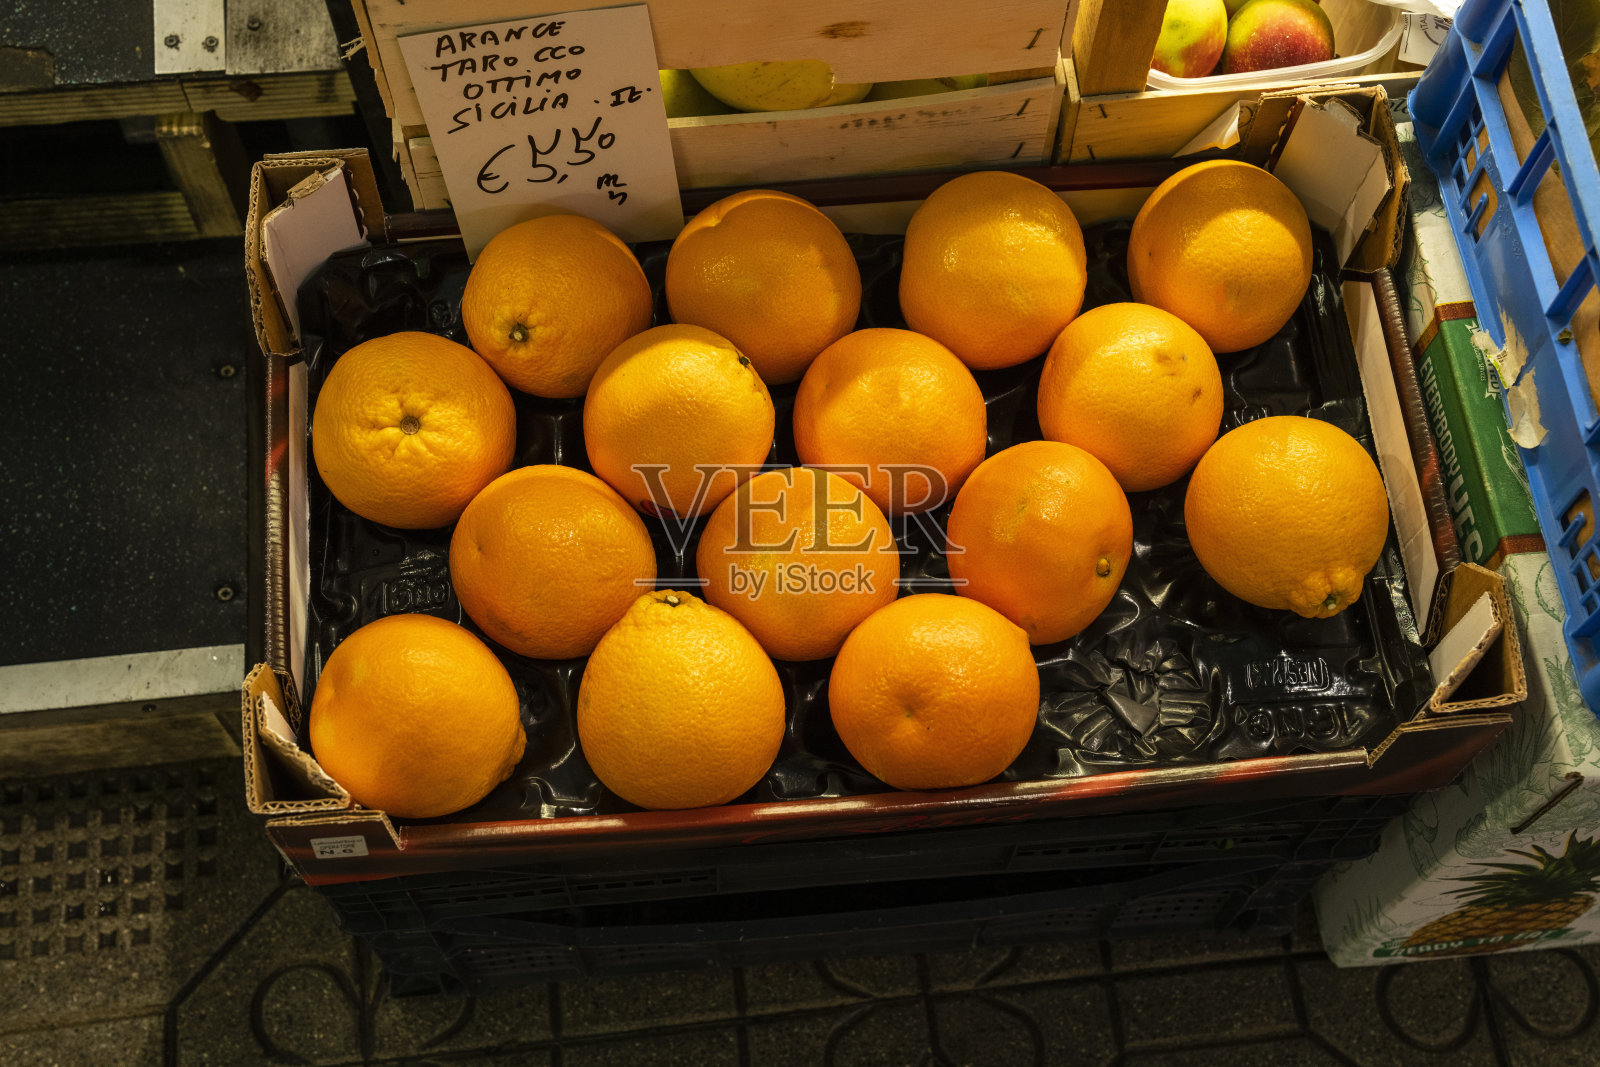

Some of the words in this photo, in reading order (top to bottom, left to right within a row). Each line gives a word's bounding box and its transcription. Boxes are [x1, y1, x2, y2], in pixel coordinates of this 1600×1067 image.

[436, 21, 566, 58] ARANCE
[463, 68, 582, 100] OTTIMO
[447, 89, 569, 134] SICILIA
[1420, 356, 1460, 477] EVERYBODY
[1477, 935, 1505, 945] TO
